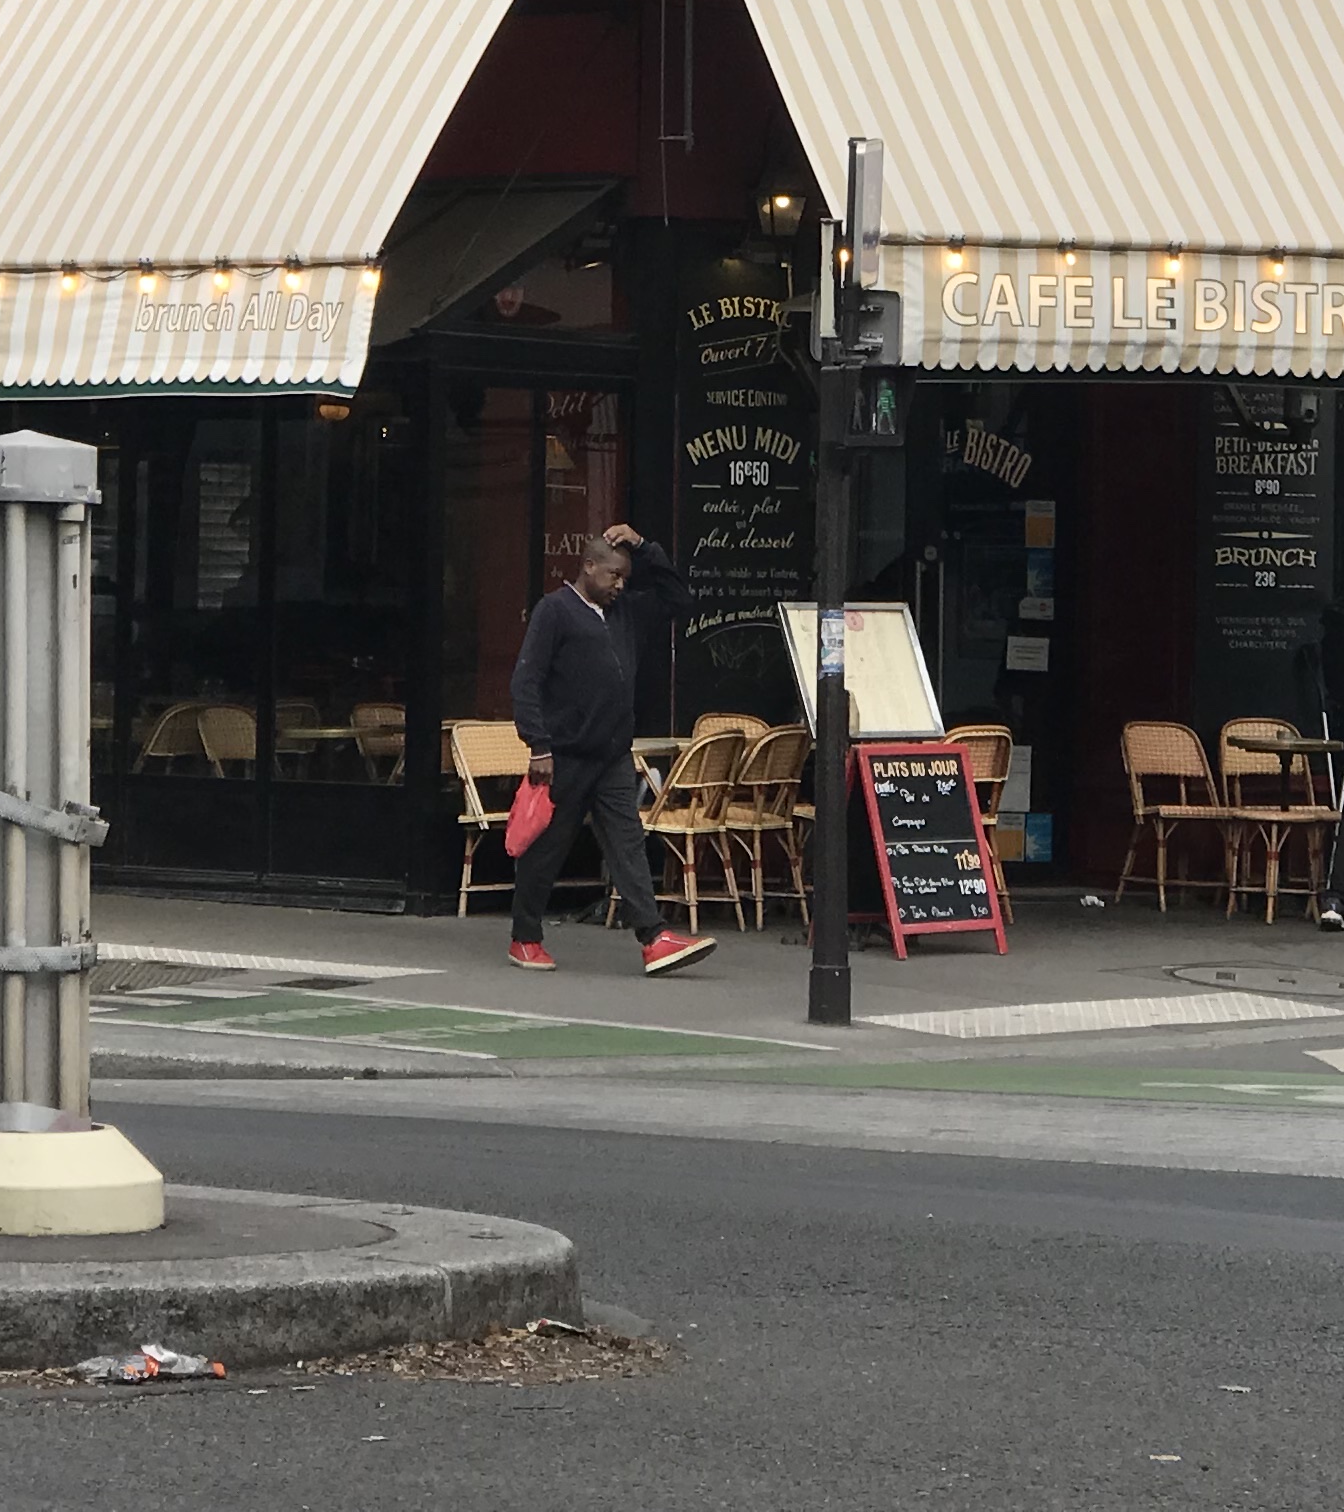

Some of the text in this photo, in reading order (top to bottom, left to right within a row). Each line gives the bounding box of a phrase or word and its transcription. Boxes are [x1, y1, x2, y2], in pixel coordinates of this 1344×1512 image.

[941, 271, 1095, 329] CAFE
[1111, 276, 1177, 330] LE
[135, 291, 344, 341] brunch All Day
[687, 302, 715, 331] LE
[700, 342, 752, 365] Ouvert
[706, 388, 746, 407] SERVICE
[686, 425, 801, 466] MENU MIDI
[946, 429, 960, 449] LE
[963, 428, 1032, 488] BISTRO
[1216, 451, 1318, 476] BREAKFAST
[749, 496, 781, 523] plat
[739, 527, 795, 549] dessert
[1215, 546, 1317, 568] BRUNCH
[873, 760, 958, 778] PLATS DU JOUR
